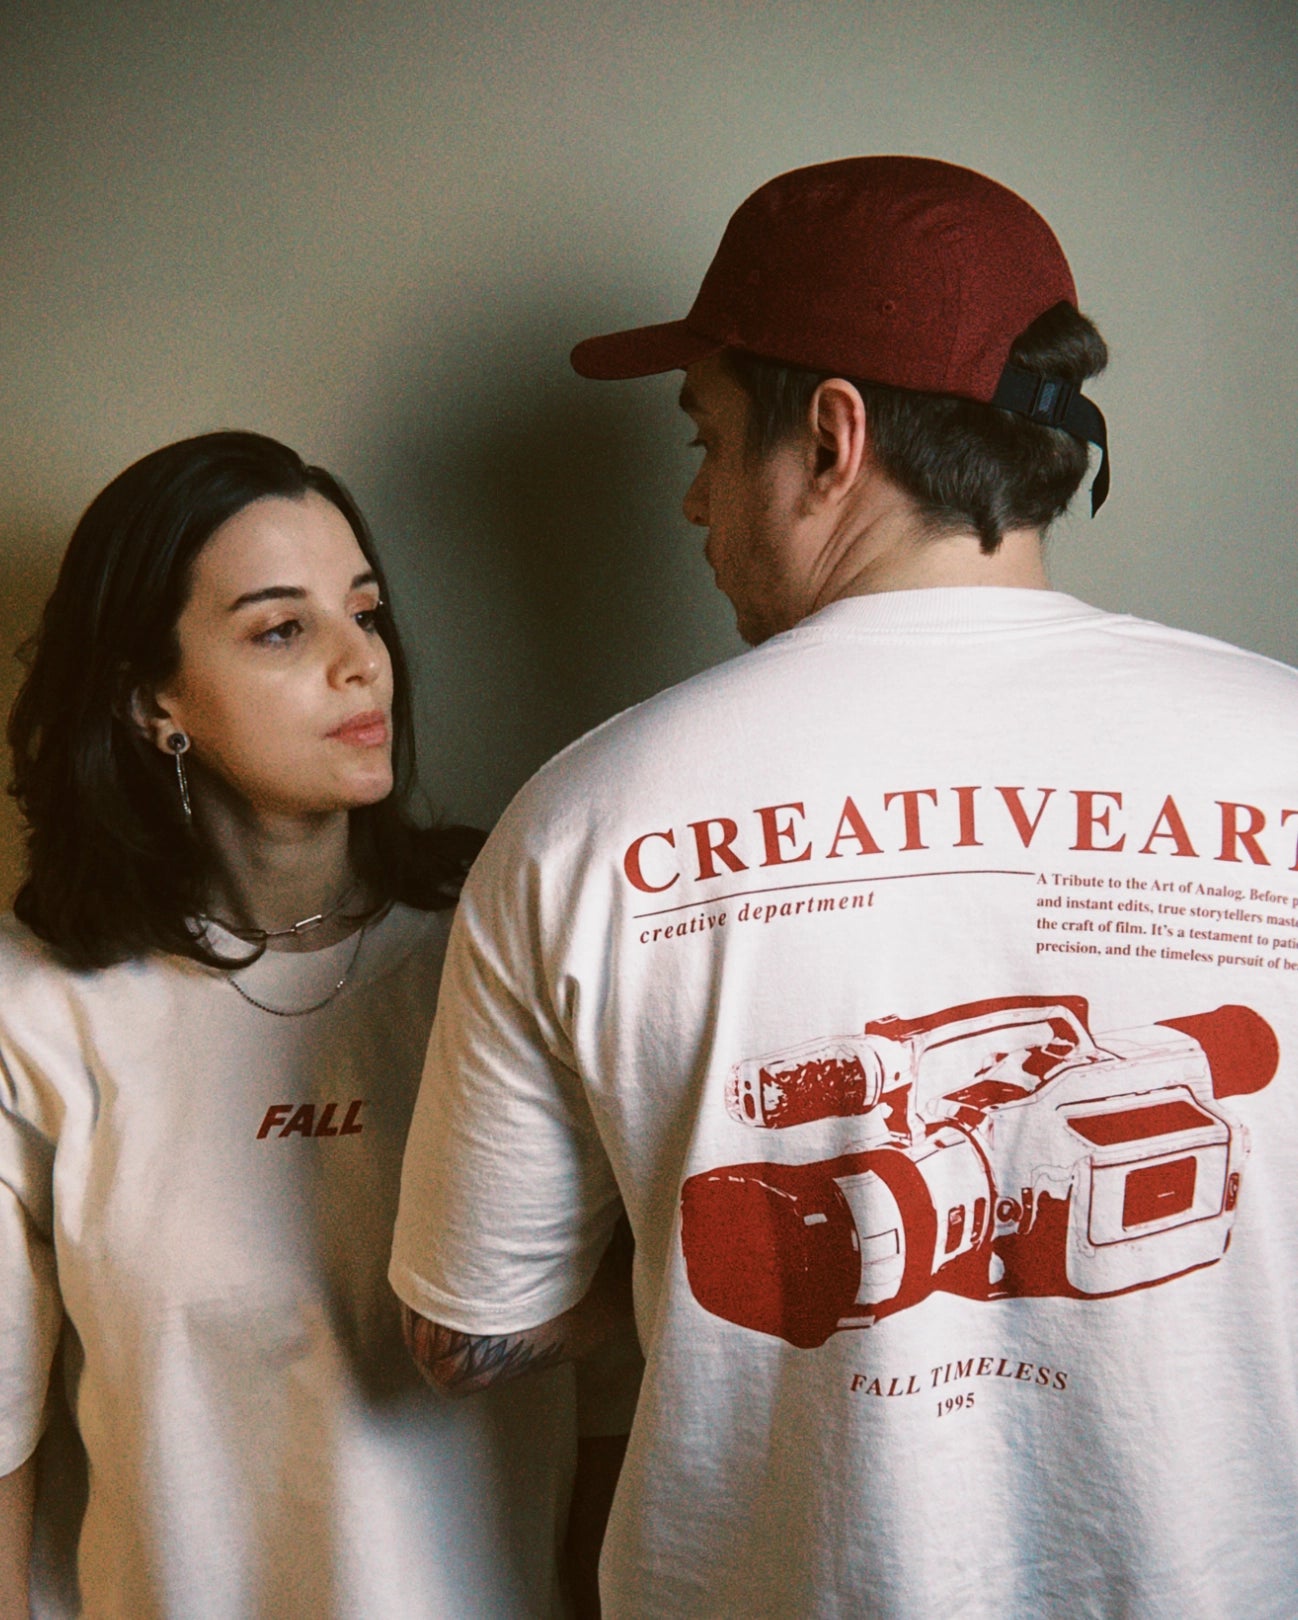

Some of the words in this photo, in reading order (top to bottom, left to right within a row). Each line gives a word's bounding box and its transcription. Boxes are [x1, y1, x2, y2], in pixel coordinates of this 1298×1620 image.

[1037, 873, 1047, 884] A
[1052, 873, 1104, 888] Tribute
[1109, 877, 1121, 889] to
[1126, 877, 1147, 890] the
[1151, 880, 1173, 892] Art
[1179, 882, 1192, 893] of
[1195, 883, 1245, 901] Analog.
[1250, 889, 1288, 905] Before
[640, 911, 727, 944] creative
[737, 891, 875, 924] department
[1037, 896, 1061, 908] and
[1066, 896, 1113, 910] instant
[1117, 900, 1153, 913] edits,
[1158, 903, 1186, 915] true
[1190, 906, 1262, 923] storytellers
[1037, 918, 1057, 929] the
[1062, 919, 1093, 931] craft
[1098, 921, 1111, 933] of
[1116, 922, 1146, 935] film.
[1177, 929, 1184, 938] a
[1189, 929, 1252, 944] testament
[1257, 935, 1268, 946] to
[1273, 936, 1298, 949] pati
[1037, 940, 1101, 955] precision,
[1105, 944, 1130, 956] and
[1136, 946, 1156, 957] the
[1161, 947, 1213, 963] timeless
[1218, 954, 1263, 967] pursuit
[1268, 957, 1281, 969] of
[1284, 958, 1298, 970] be
[256, 1100, 363, 1139] FALL
[850, 1373, 921, 1397] FALL
[931, 1357, 1068, 1391] TIMELESS
[937, 1392, 975, 1418] 1995
